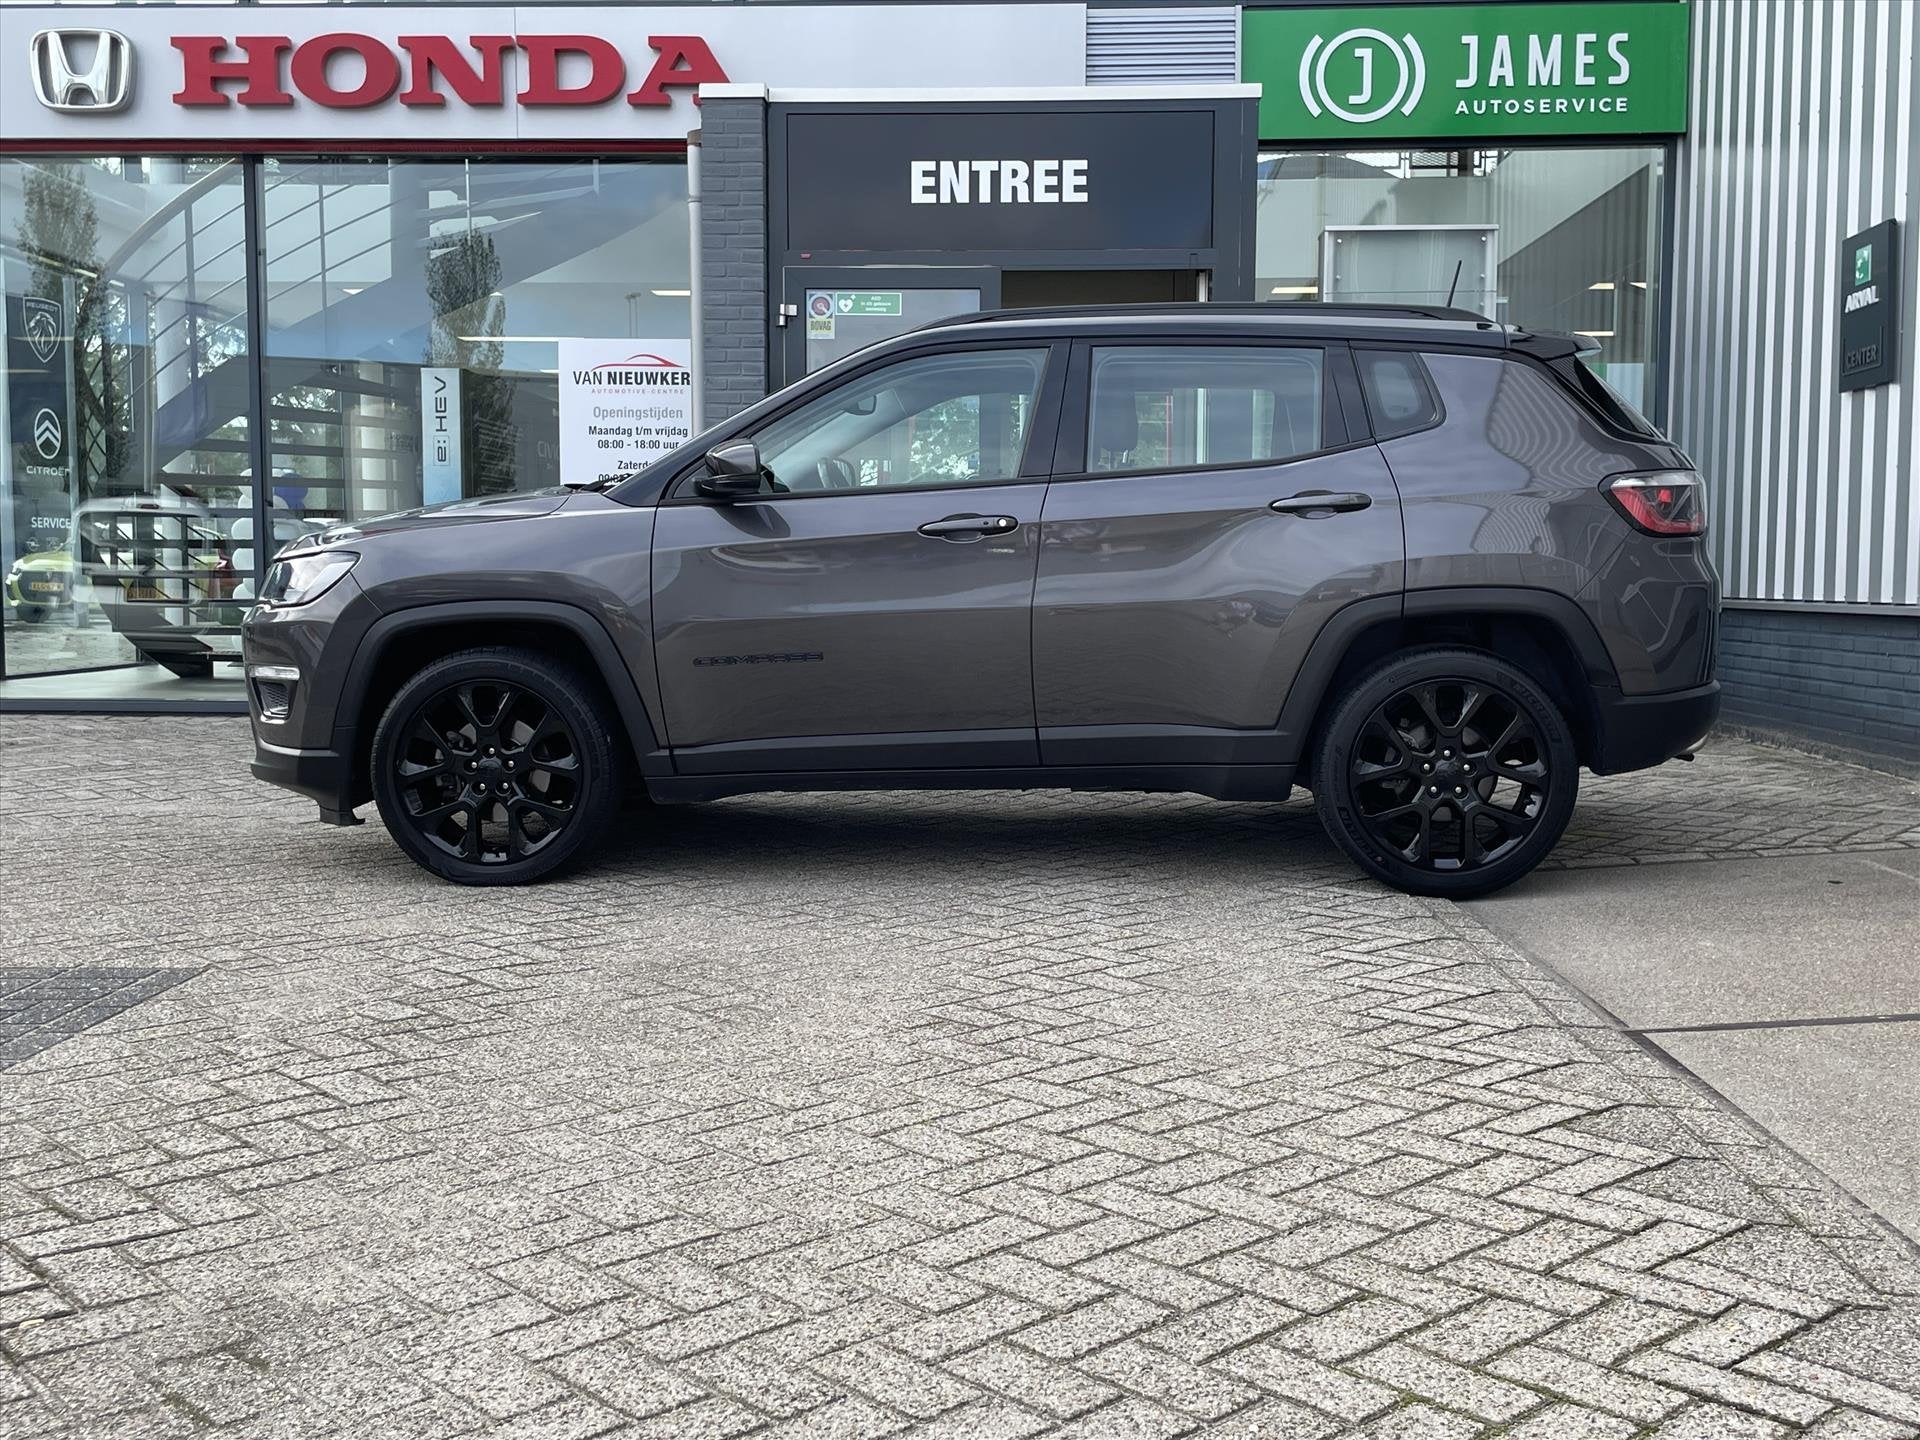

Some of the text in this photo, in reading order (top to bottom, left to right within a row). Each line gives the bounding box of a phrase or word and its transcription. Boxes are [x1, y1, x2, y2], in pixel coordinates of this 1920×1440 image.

[1455, 32, 1630, 88] JAMES
[170, 32, 731, 107] HONDA
[1455, 97, 1629, 115] AUTOSERVICE
[910, 159, 1089, 204] ENTREE
[1844, 285, 1880, 313] ARVAL
[1846, 344, 1877, 369] CENTER
[573, 371, 691, 386] VAN NIEUWKER
[593, 406, 684, 421] Openingstijden
[588, 426, 689, 438] Maandag t/m vrijdag
[597, 440, 624, 449] 08:00
[634, 440, 660, 449] 18:00
[663, 441, 680, 449] uur
[617, 460, 652, 470] Zaterd
[31, 516, 71, 529] SERVICE
